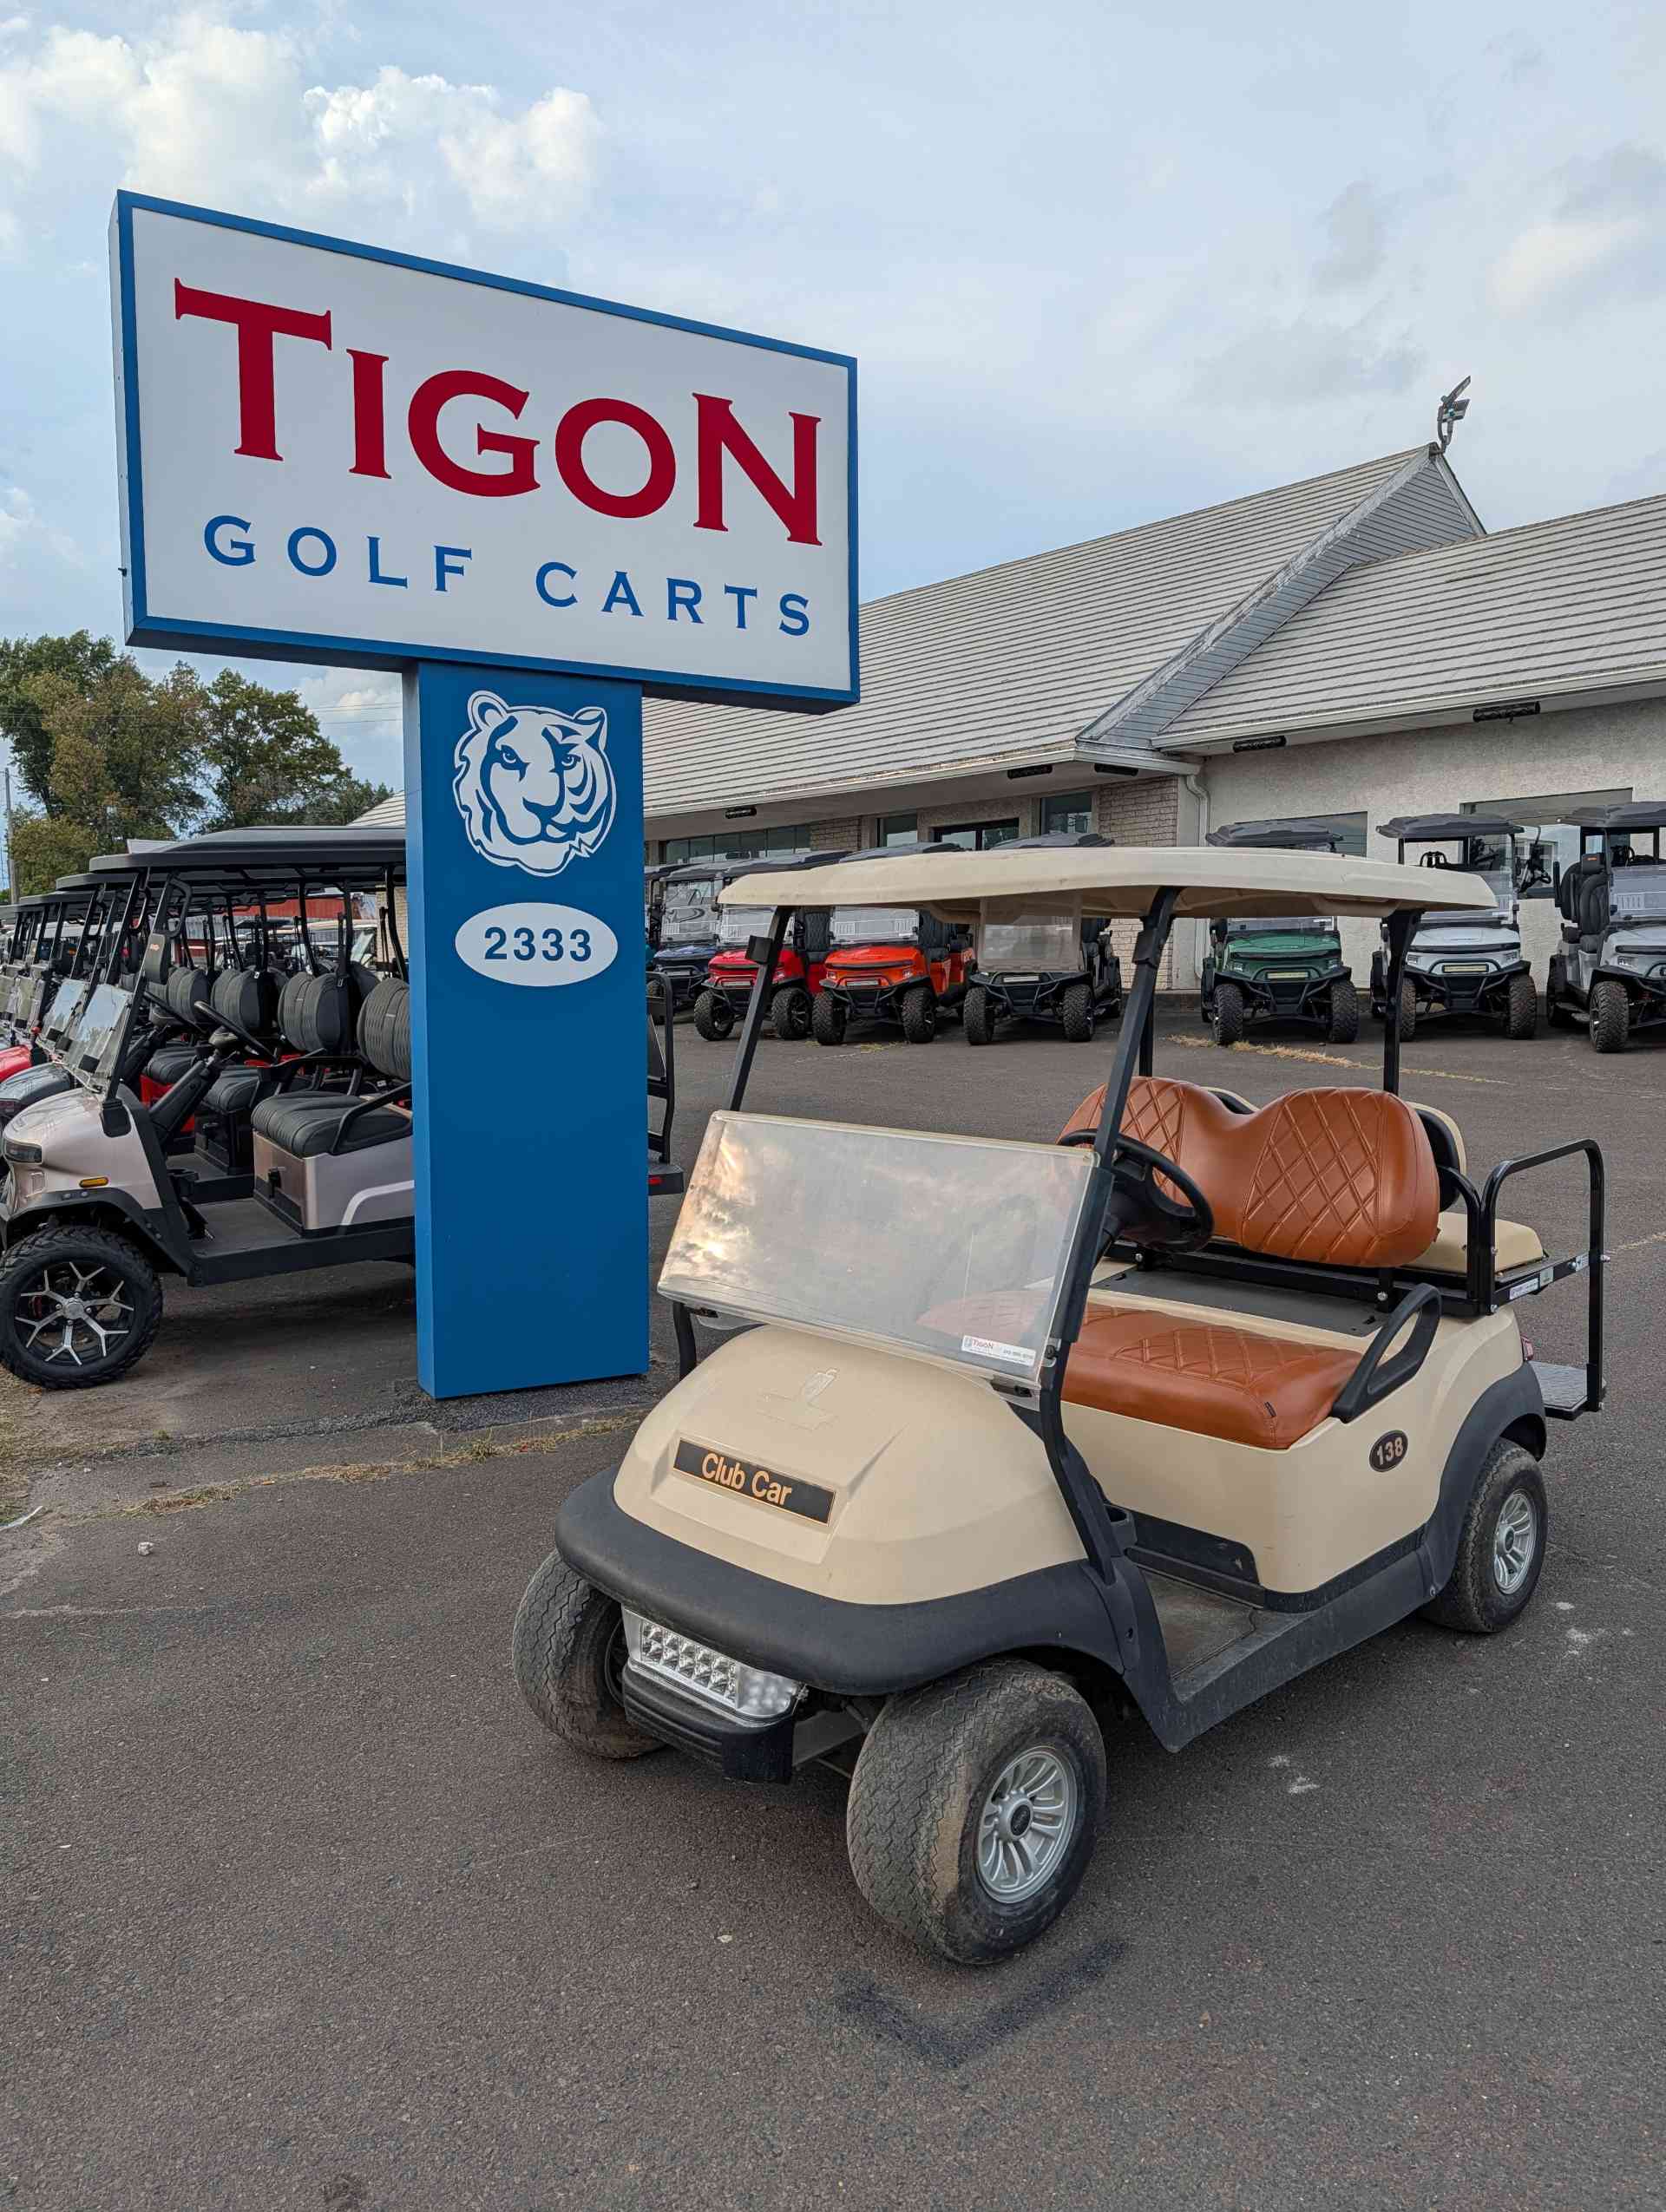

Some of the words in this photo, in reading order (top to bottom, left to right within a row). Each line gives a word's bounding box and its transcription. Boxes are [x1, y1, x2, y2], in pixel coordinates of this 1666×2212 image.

[175, 278, 823, 546] TIGON
[203, 514, 473, 592] GOLF
[535, 561, 810, 637] CARTS
[484, 926, 592, 962] 2333
[1377, 1436, 1404, 1465] 138
[702, 1453, 745, 1489] Club
[751, 1470, 792, 1506] Car
